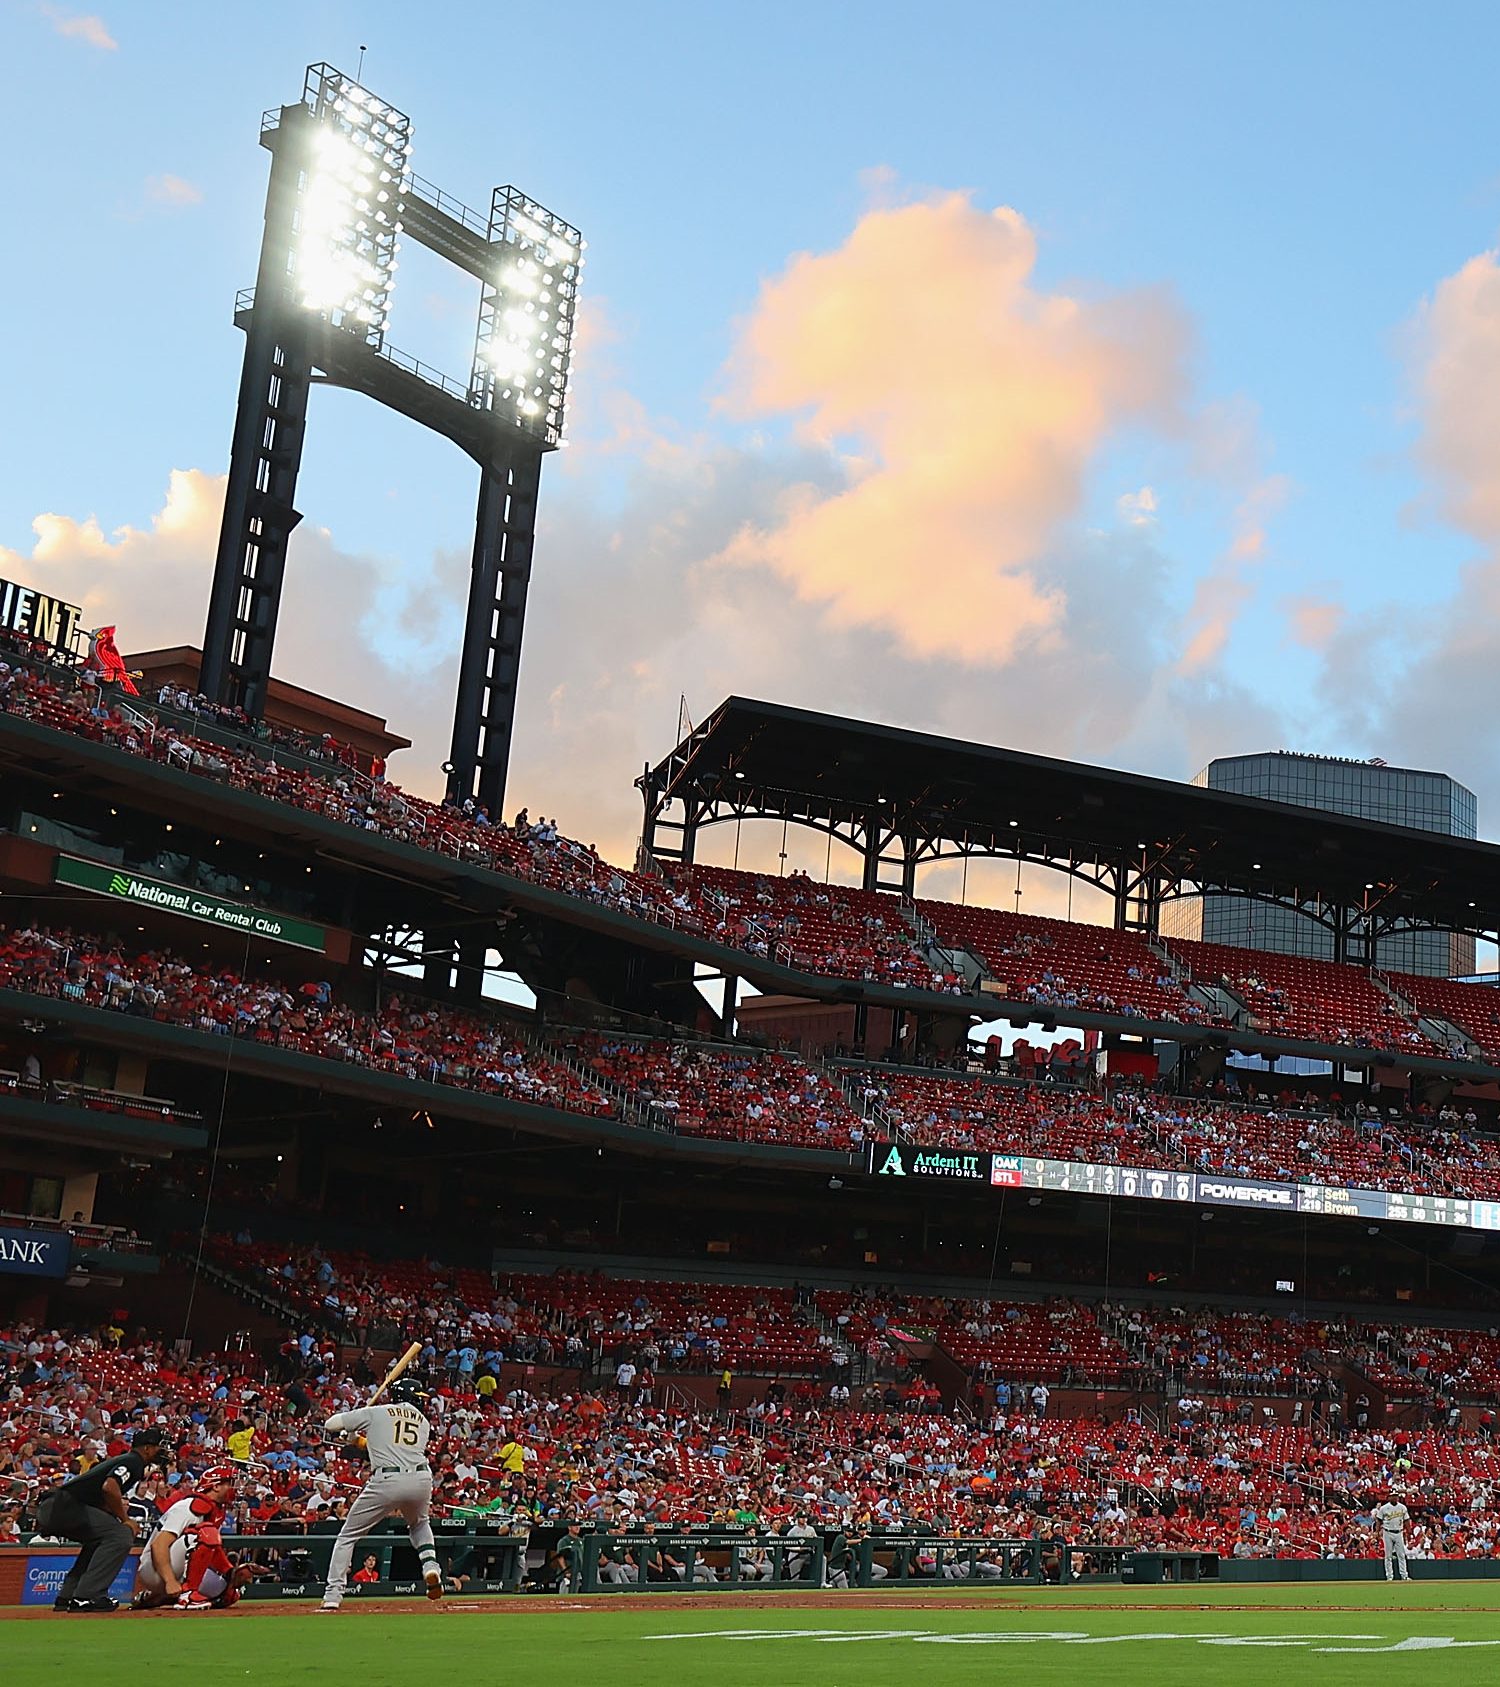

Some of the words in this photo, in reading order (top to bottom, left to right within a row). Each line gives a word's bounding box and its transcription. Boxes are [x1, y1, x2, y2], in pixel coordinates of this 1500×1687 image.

[0, 582, 82, 649] IENT
[1279, 750, 1305, 758] BANK
[1324, 755, 1366, 765] AMERICA
[128, 881, 189, 911] National
[191, 901, 213, 917] Car
[215, 908, 253, 928] Rental
[255, 918, 282, 936] Club
[913, 1152, 960, 1169] Ardent
[963, 1156, 979, 1170] IT
[995, 1158, 1019, 1170] OAK
[913, 1164, 977, 1178] SOLUTIONS
[1036, 1160, 1044, 1173] 0
[1063, 1163, 1069, 1175] 1
[1086, 1165, 1094, 1178] 0
[1121, 1169, 1138, 1179] BALL
[994, 1172, 1015, 1184] STL
[1037, 1175, 1043, 1187] 1
[1061, 1178, 1070, 1190] 4
[1087, 1180, 1093, 1192] 1
[1124, 1178, 1136, 1196] 0
[1151, 1180, 1163, 1198] 0
[1177, 1182, 1189, 1200] 0
[1200, 1183, 1291, 1204] POWERADE
[1325, 1187, 1349, 1201] Seth
[1325, 1201, 1359, 1216] Brown
[1435, 1210, 1446, 1222] 11
[387, 1408, 424, 1423] BROWN
[394, 1420, 419, 1446] 15
[282, 1587, 299, 1595] Mercy
[395, 1585, 411, 1593] Mercy
